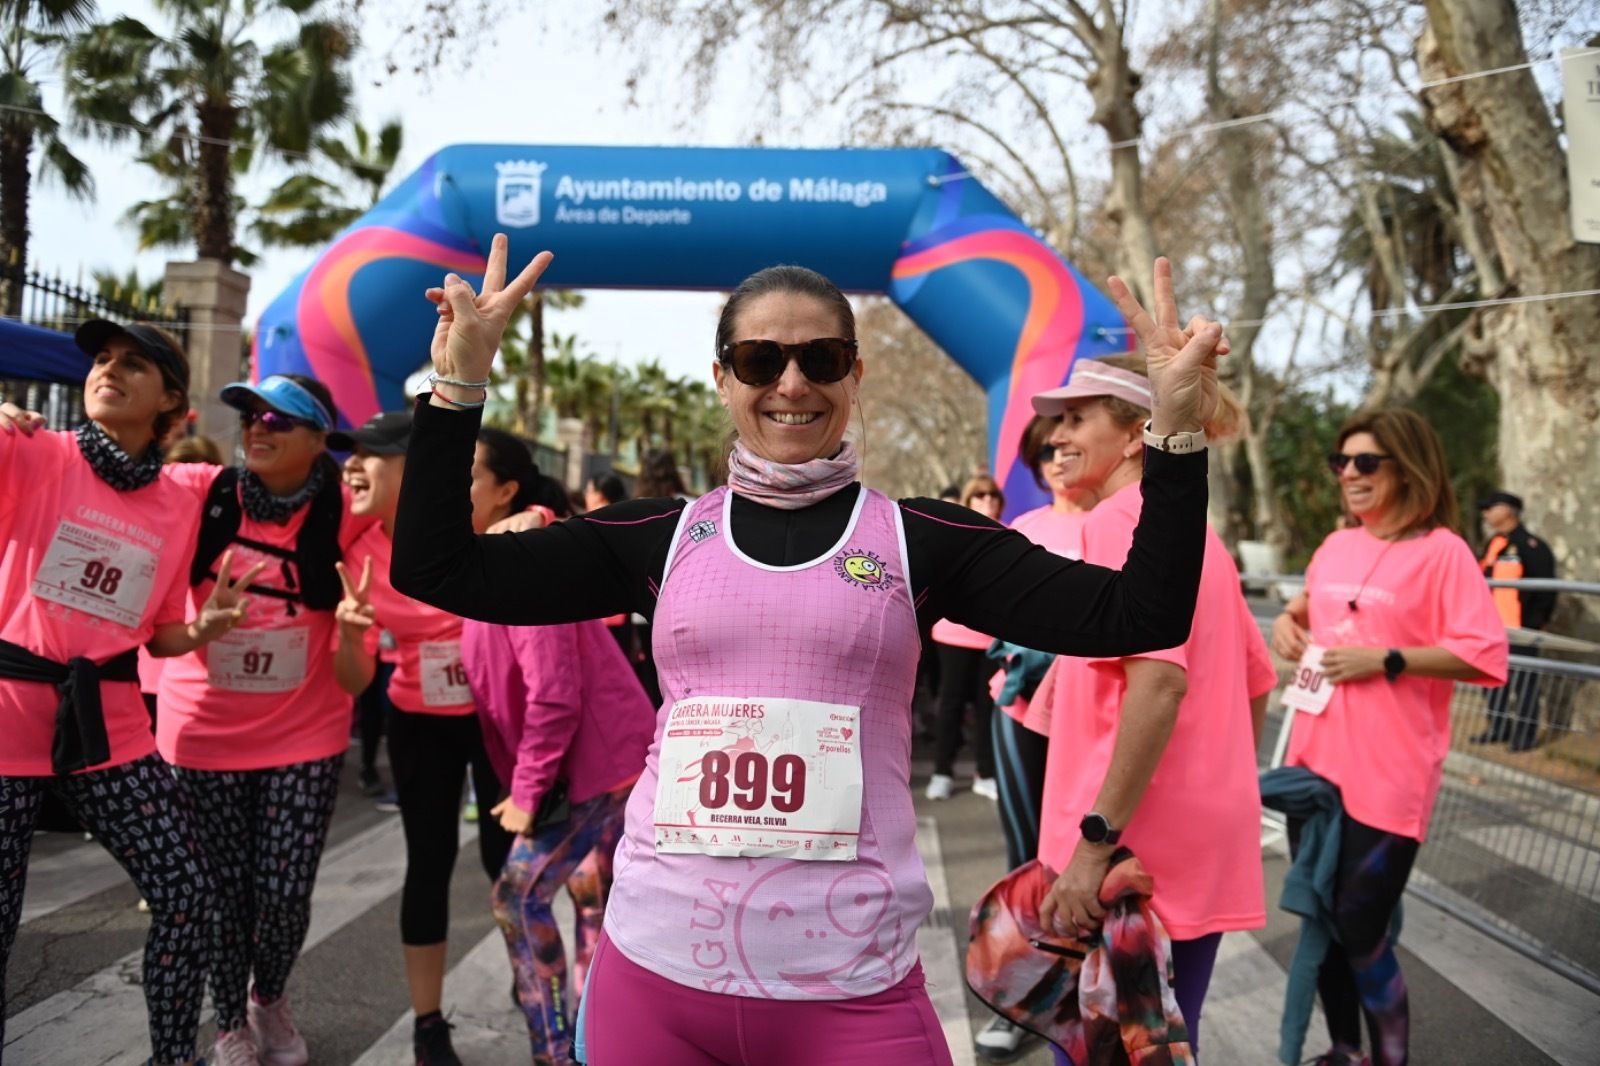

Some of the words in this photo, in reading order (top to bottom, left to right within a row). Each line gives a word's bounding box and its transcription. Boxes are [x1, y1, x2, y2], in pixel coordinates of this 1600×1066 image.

[555, 175, 742, 205] Ayuntamiento
[748, 177, 783, 202] de
[789, 177, 887, 208] Málaga
[555, 202, 596, 224] Área
[598, 206, 620, 224] de
[622, 205, 691, 227] Deporte
[80, 560, 123, 595] 98
[243, 651, 274, 675] 97
[671, 703, 709, 719] CARRERA
[711, 703, 765, 718] MUJERES
[699, 750, 806, 813] 899
[710, 814, 742, 824] BECERRA
[763, 816, 787, 826] SILVIA
